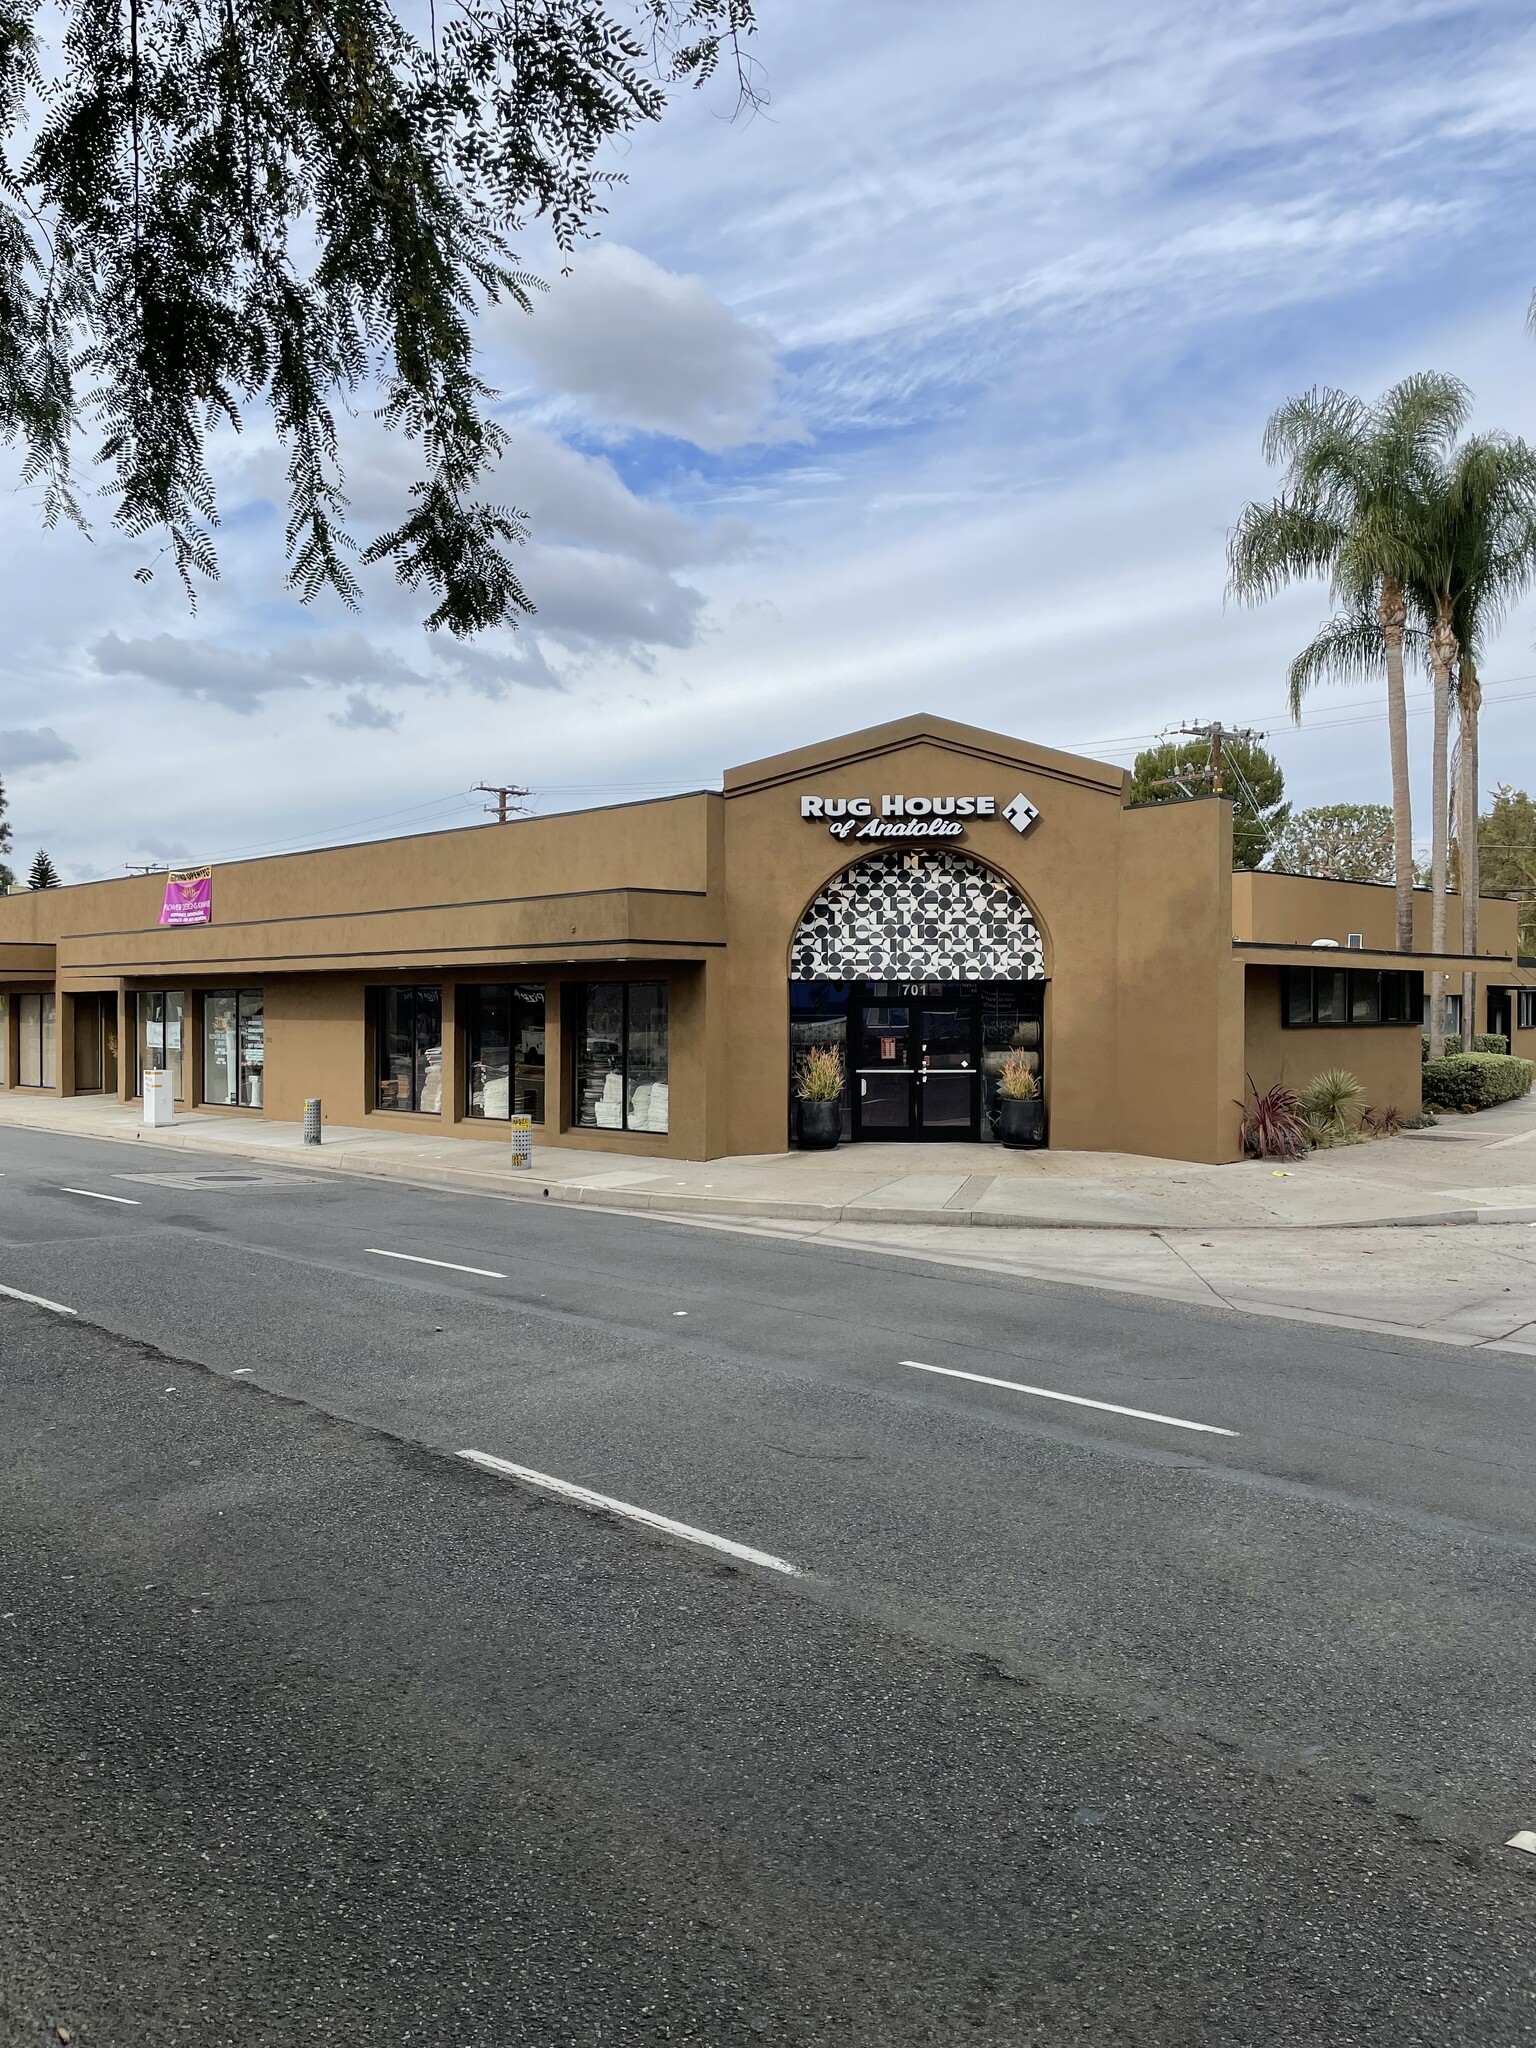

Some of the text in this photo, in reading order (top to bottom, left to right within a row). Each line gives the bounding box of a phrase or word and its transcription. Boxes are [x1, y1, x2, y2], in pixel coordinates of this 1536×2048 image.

[801, 794, 995, 817] RUG HOUSE
[830, 818, 964, 838] of Anatolia
[902, 984, 926, 996] 701
